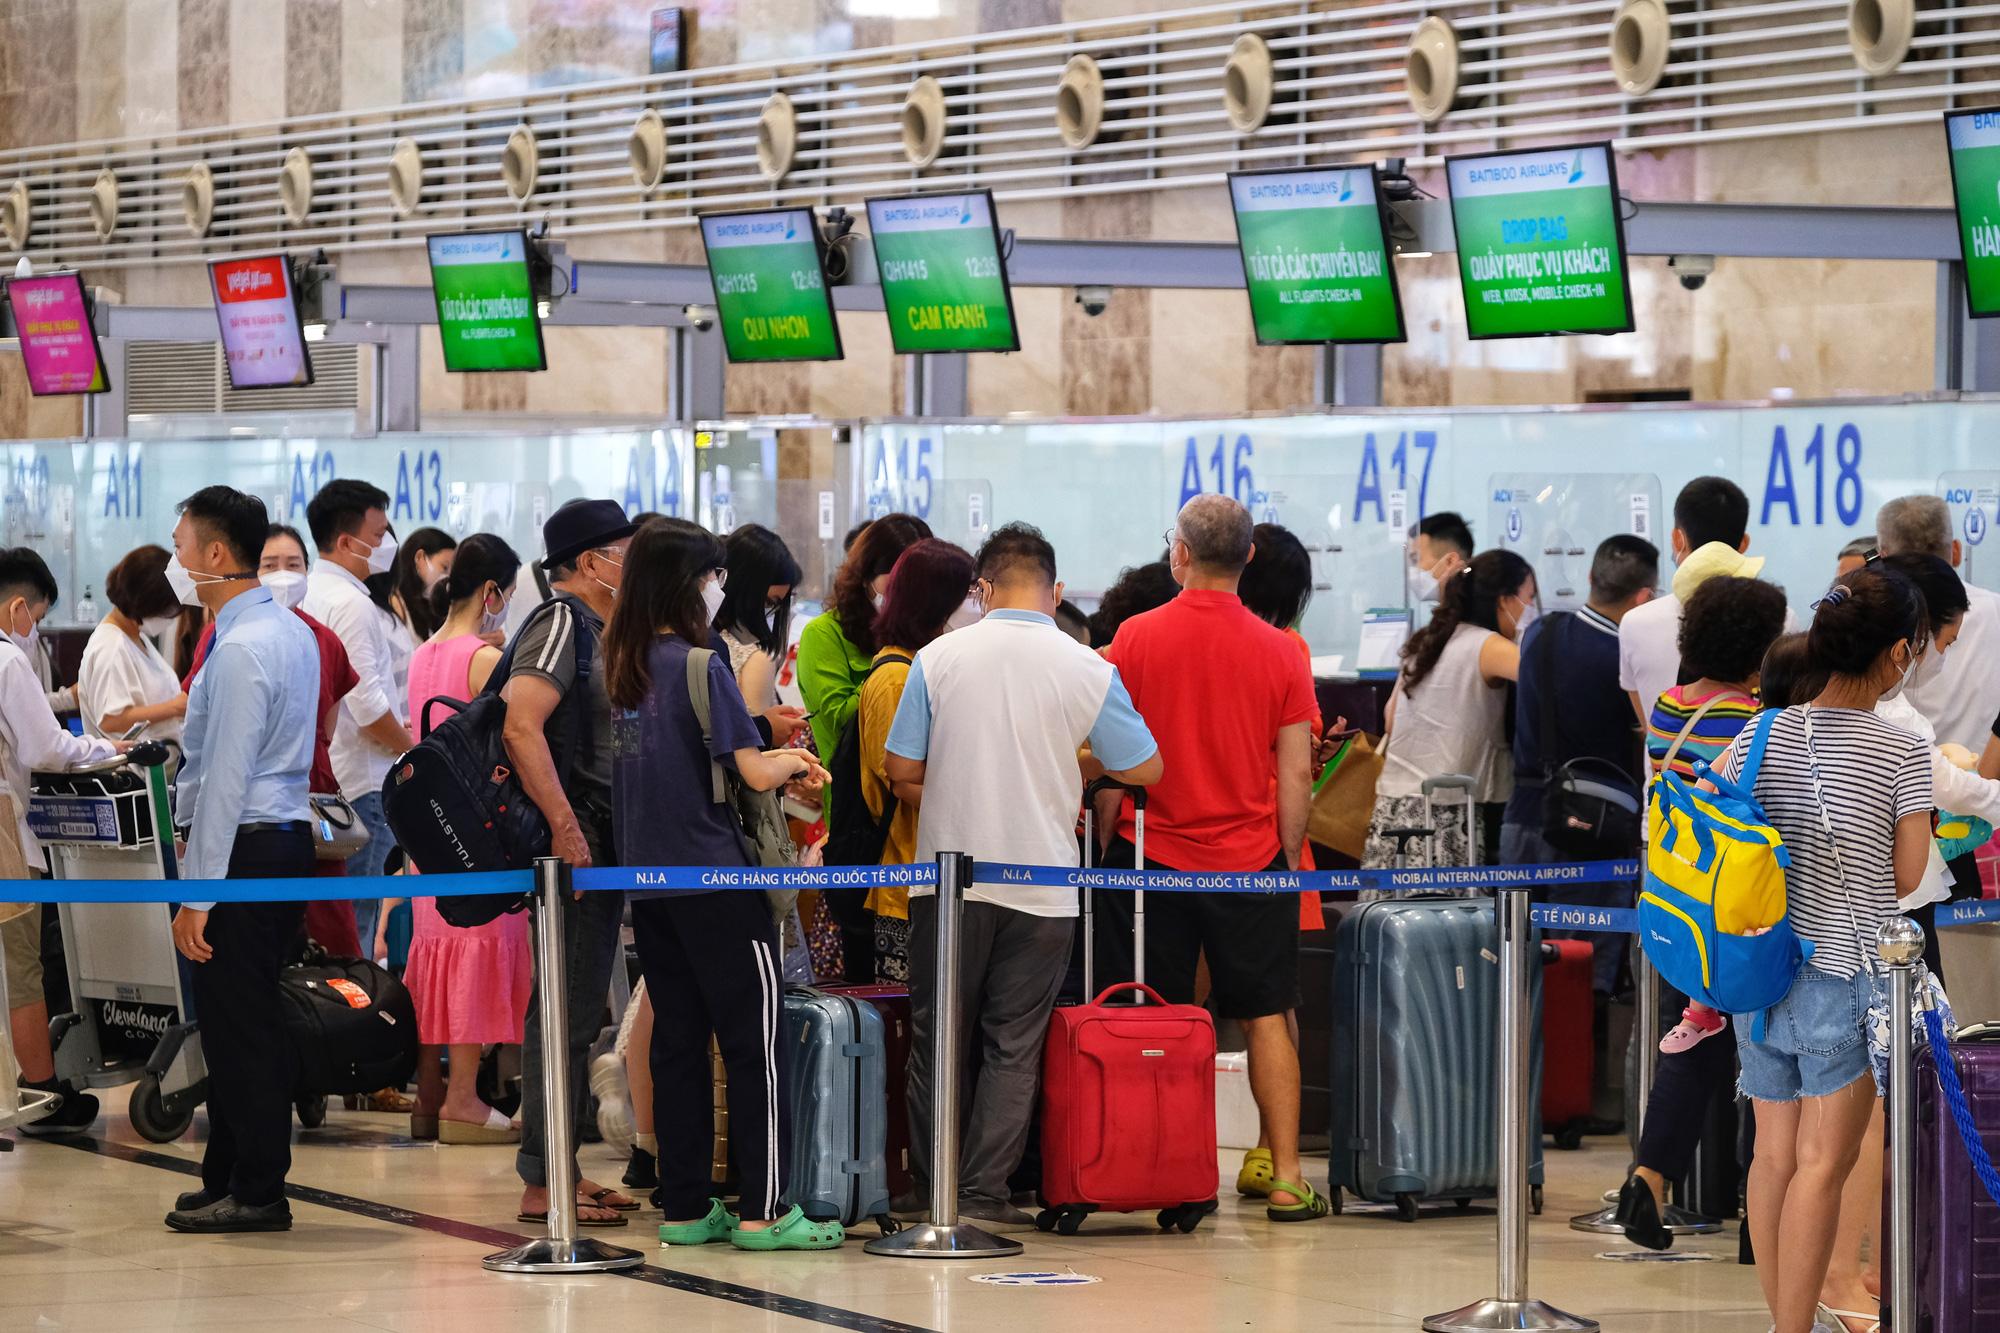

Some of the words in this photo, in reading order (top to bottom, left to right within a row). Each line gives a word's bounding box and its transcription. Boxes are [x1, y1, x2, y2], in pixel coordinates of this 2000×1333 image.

[1470, 168, 1516, 183] BAMBOO
[1520, 162, 1568, 177] AIRWAYS
[1251, 184, 1292, 198] BAMBOO
[1296, 181, 1338, 195] AIRWAYS
[1502, 217, 1538, 244] DROP
[1539, 215, 1568, 241] BAG
[1359, 251, 1381, 277] BAY
[1506, 251, 1542, 284] PHỤC
[1544, 251, 1563, 282] VỤ
[1563, 241, 1610, 276] KHÁCH
[1504, 287, 1532, 304] KIOSK,
[1532, 285, 1563, 301] MOBILE
[1565, 278, 1605, 298] CHECK-IN
[743, 317, 769, 341] QUI
[907, 305, 943, 331] CAM
[942, 303, 988, 330] RANH
[104, 453, 141, 518] A11
[393, 449, 442, 520] A13
[869, 438, 933, 518] A15
[1178, 433, 1253, 513] A16
[1353, 431, 1437, 522] A17
[1760, 422, 1863, 526] A18
[1946, 488, 1973, 504] ACV
[430, 799, 475, 869] FULLSTOP
[636, 872, 667, 884] N.I.A
[702, 870, 739, 885] CẢNG
[783, 871, 828, 884] KHÔNG
[832, 868, 867, 884] QUỐC
[871, 867, 886, 883] TẾ
[890, 867, 911, 884] NỘI
[1002, 869, 1032, 881] N.I.A
[1148, 874, 1193, 888] KHÔNG
[1196, 873, 1232, 888] QUỐC
[1236, 873, 1251, 888] TẾ
[1331, 875, 1360, 886] N.I.A
[1392, 873, 1433, 884] NOIBAI
[1437, 870, 1531, 883] INTERNATIONAL
[1535, 866, 1584, 880] AIRPORT
[1543, 907, 1559, 922] TẾ
[1954, 906, 1985, 919] N.I.A
[103, 1001, 174, 1033] Cleveland
